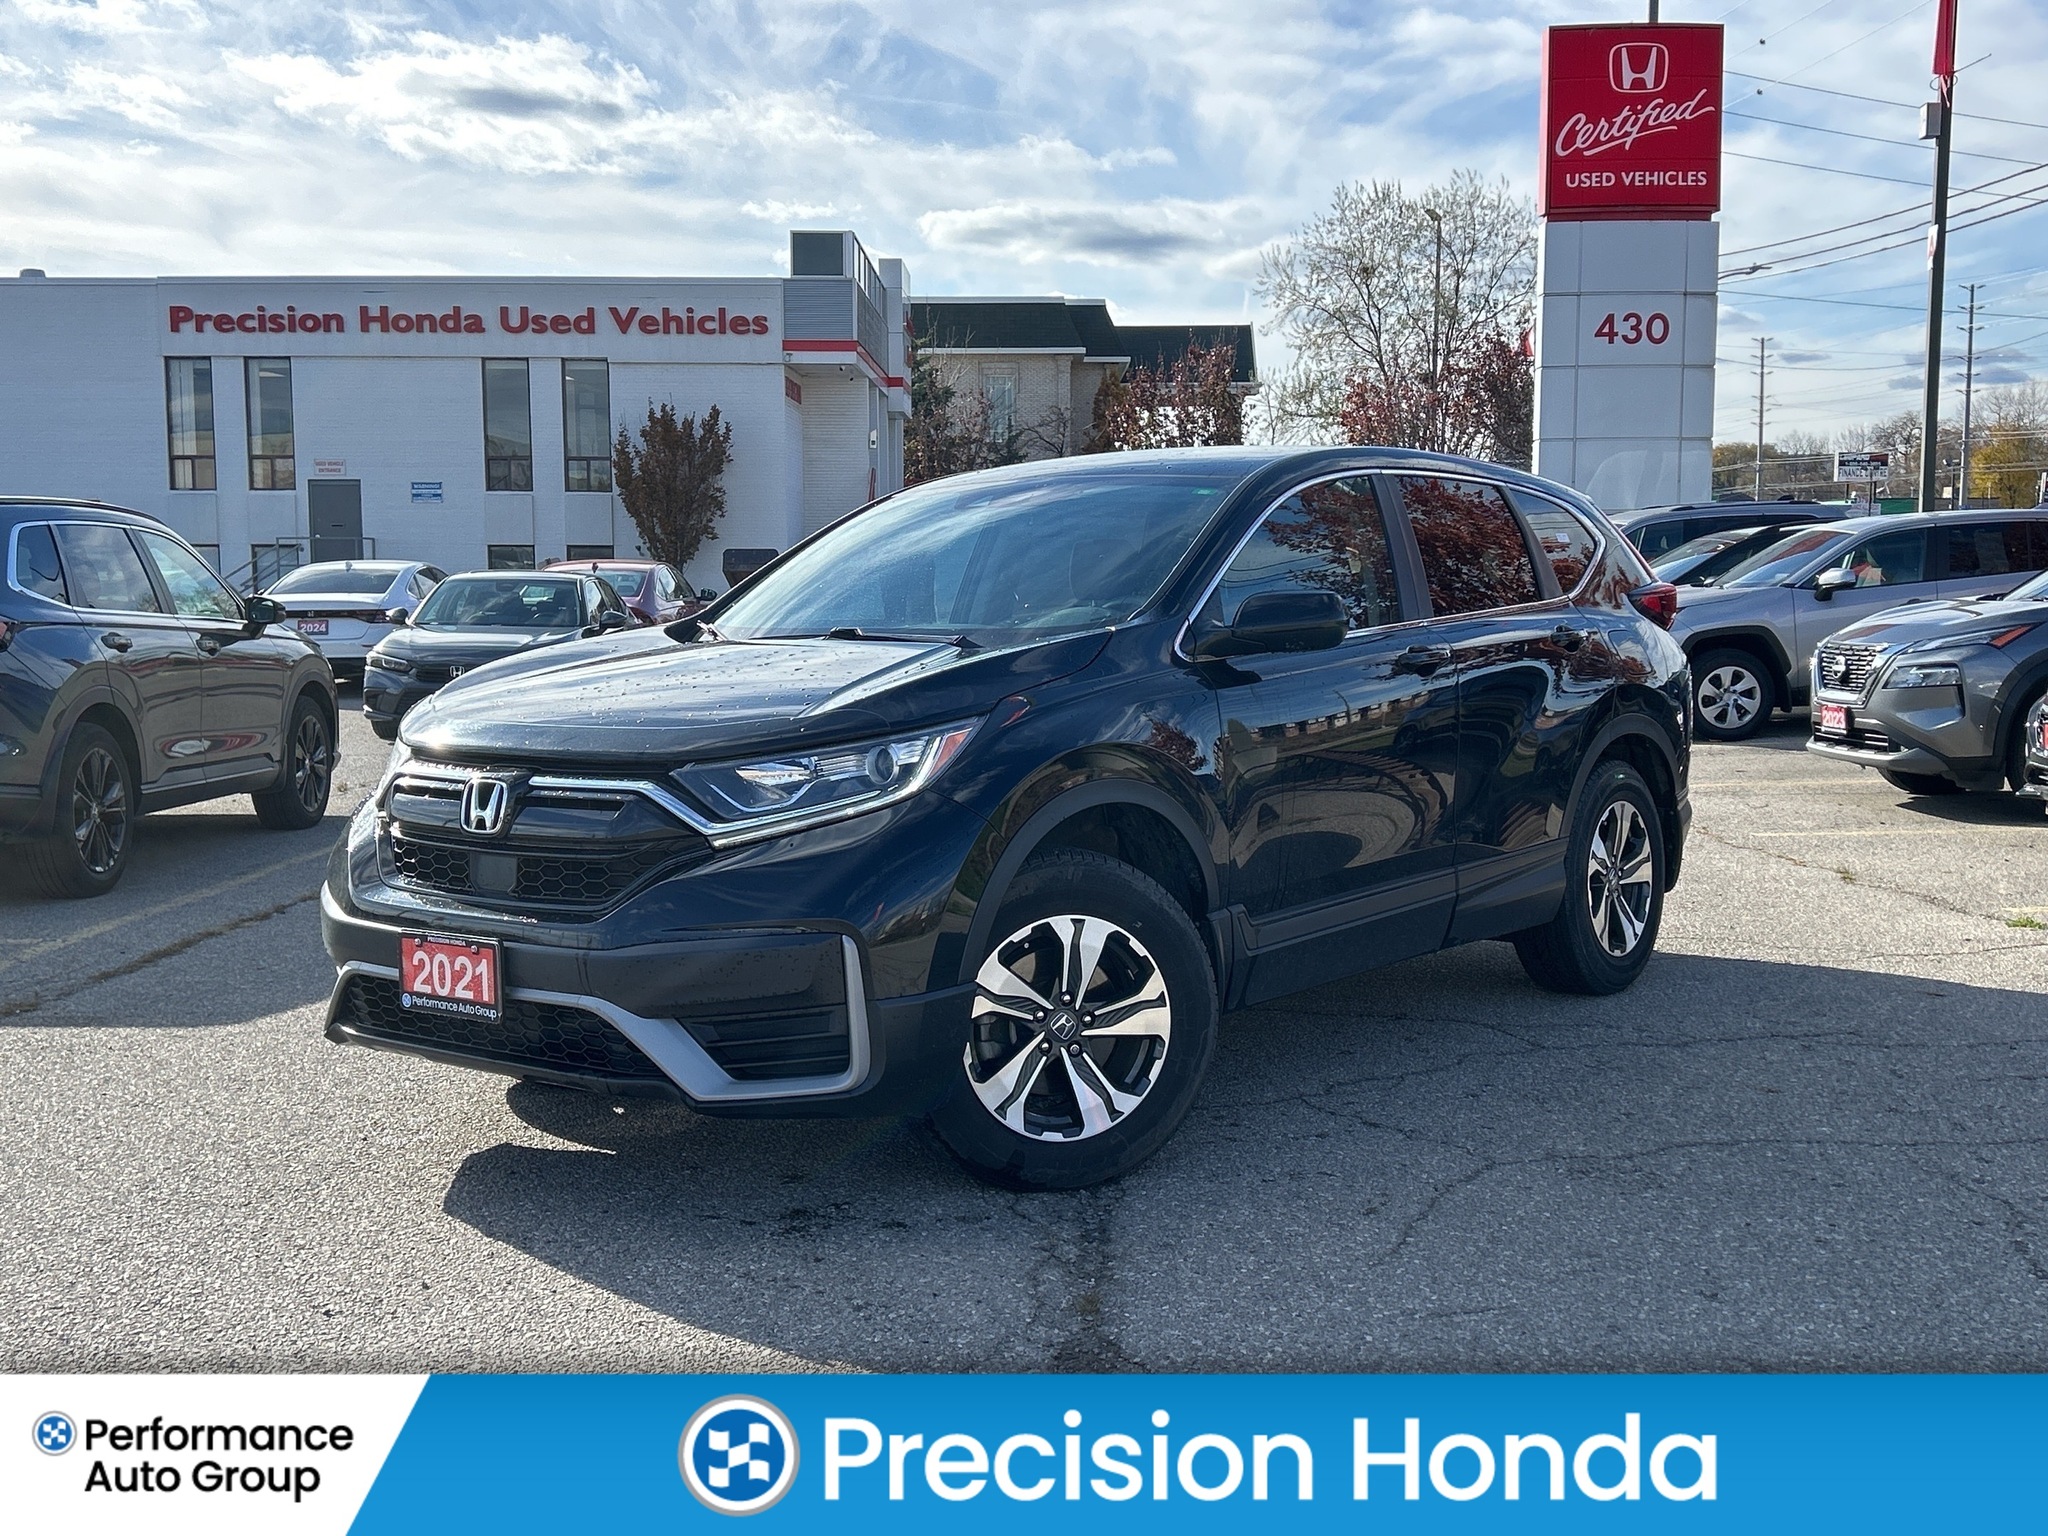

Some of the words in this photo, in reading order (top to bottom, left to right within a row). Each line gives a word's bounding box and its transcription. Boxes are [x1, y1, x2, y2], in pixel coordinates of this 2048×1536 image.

[1555, 88, 1715, 157] Certified
[1566, 172, 1616, 188] USED
[1622, 170, 1708, 187] VEHICLES
[169, 305, 346, 334] Precision
[359, 305, 486, 334] Honda
[499, 306, 597, 335] Used
[609, 307, 769, 336] Vehicles
[1593, 312, 1671, 345] 430
[300, 623, 326, 632] 2024
[1822, 710, 1846, 728] 2023
[412, 950, 489, 1002] 2021
[412, 995, 458, 1012] Performance
[458, 1003, 475, 1015] Auto
[475, 1005, 497, 1020] Group
